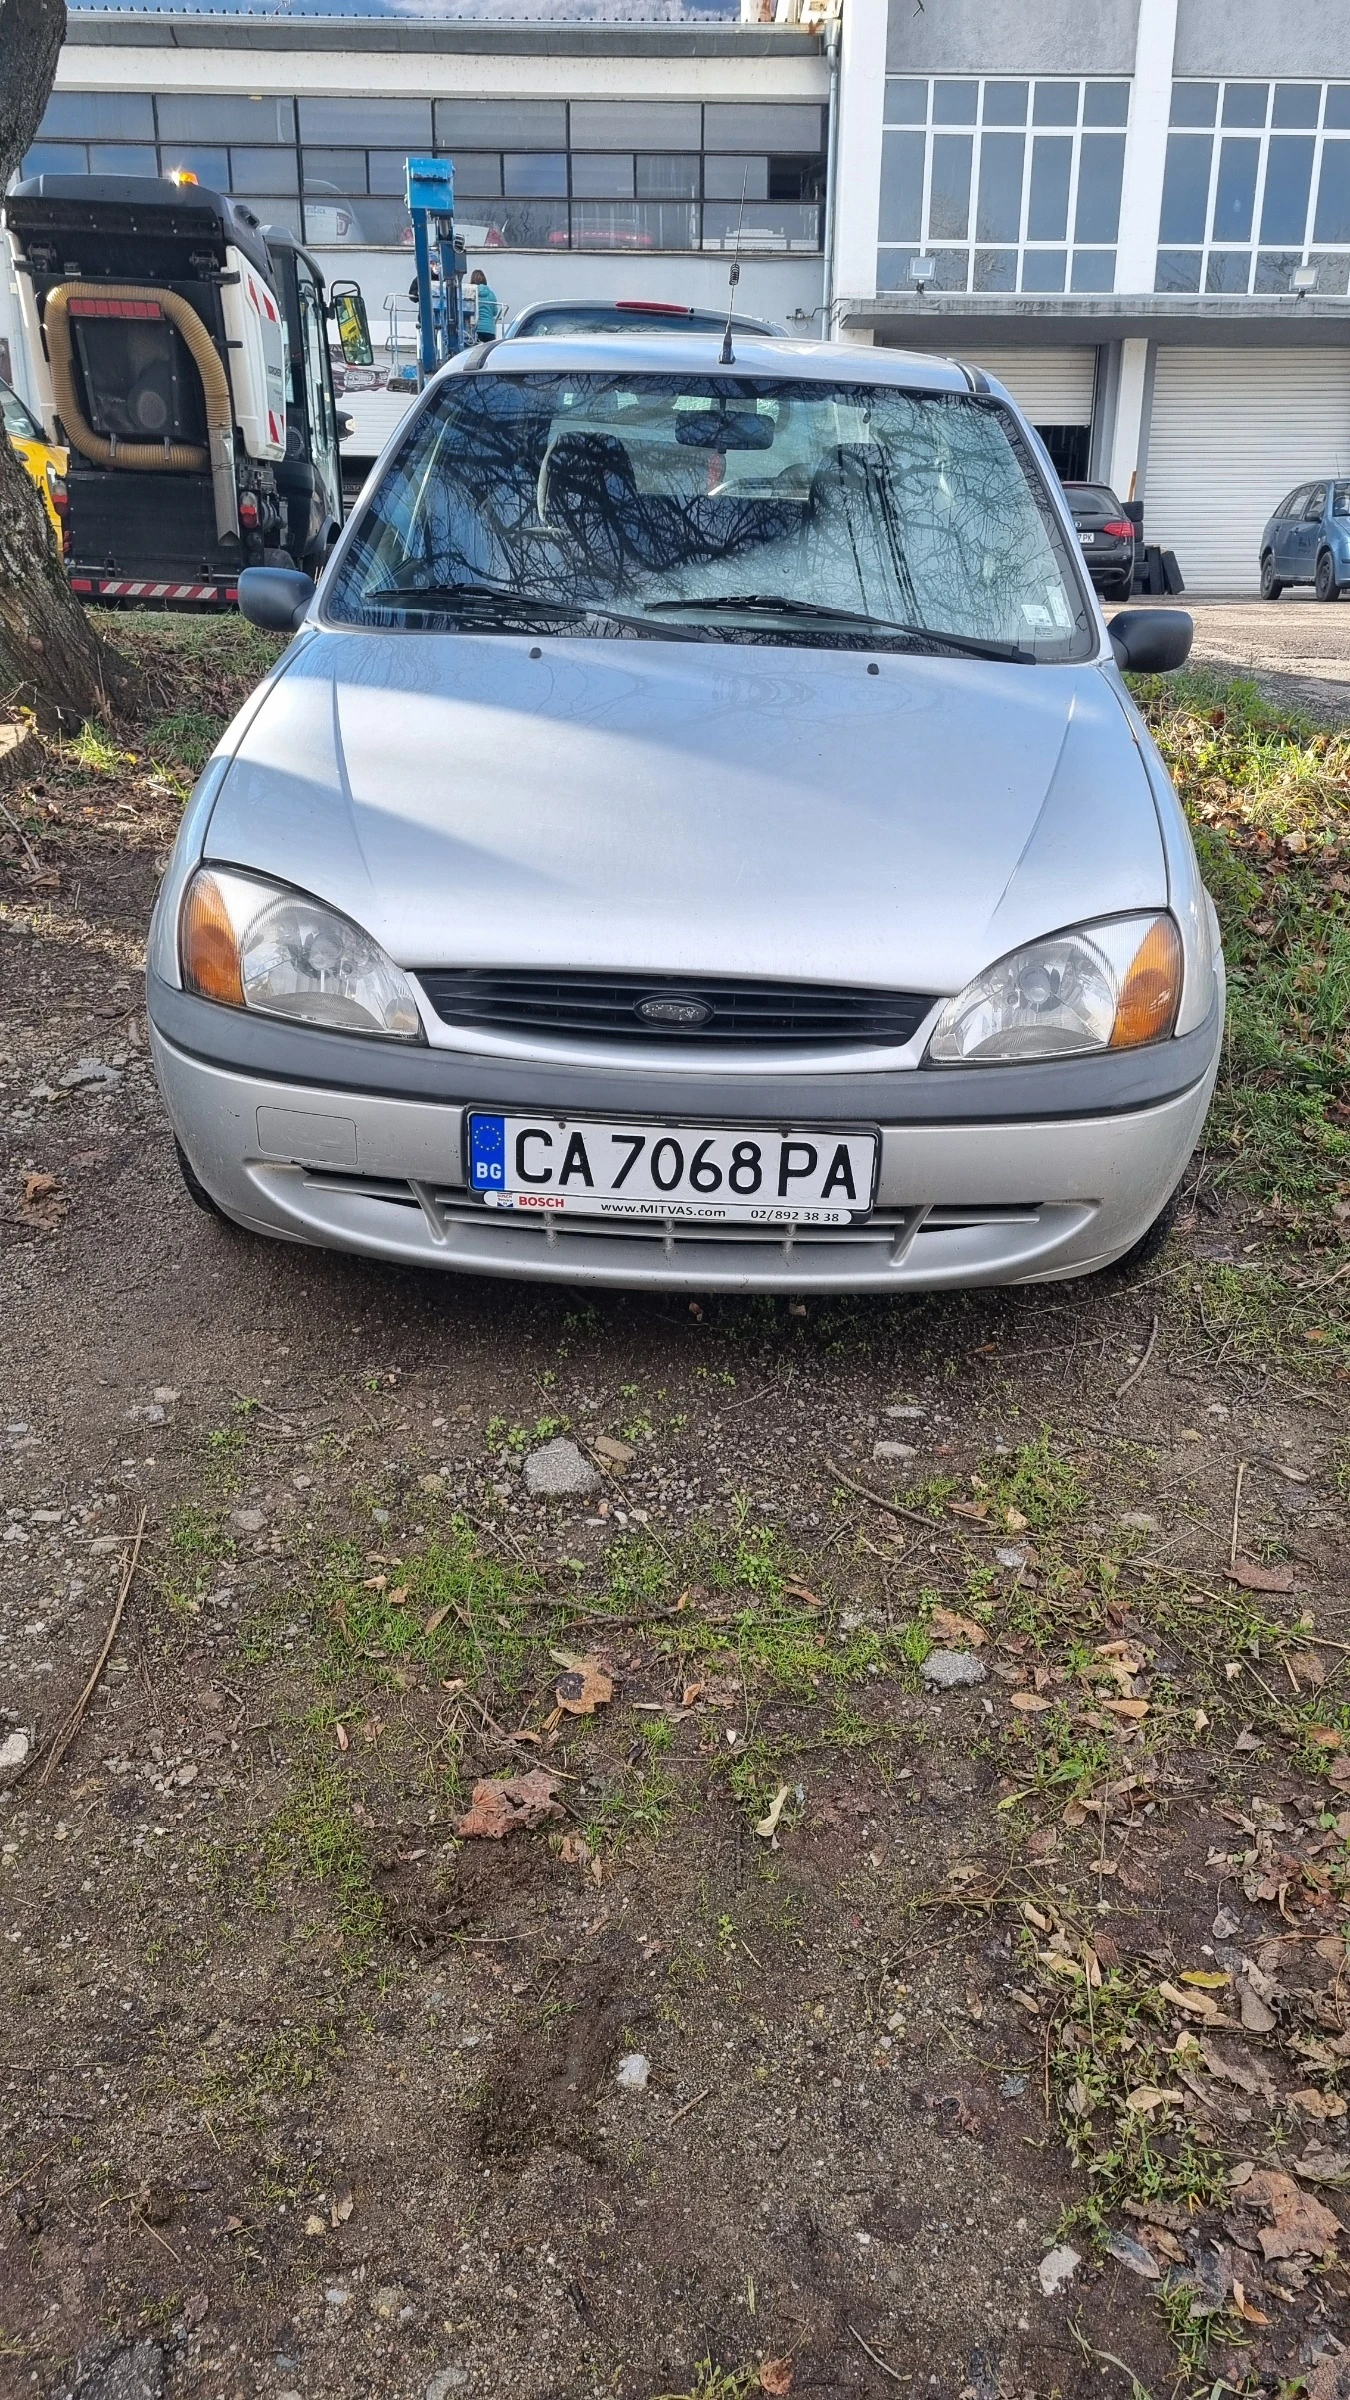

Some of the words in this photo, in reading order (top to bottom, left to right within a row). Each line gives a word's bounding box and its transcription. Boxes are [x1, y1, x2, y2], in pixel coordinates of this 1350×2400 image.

[476, 1162, 502, 1180] BG
[518, 1195, 565, 1208] BOSCH
[600, 1203, 726, 1218] www.MITVAS.com
[750, 1209, 799, 1222] 02/892
[803, 1212, 819, 1222] 38
[823, 1213, 840, 1223] 38
